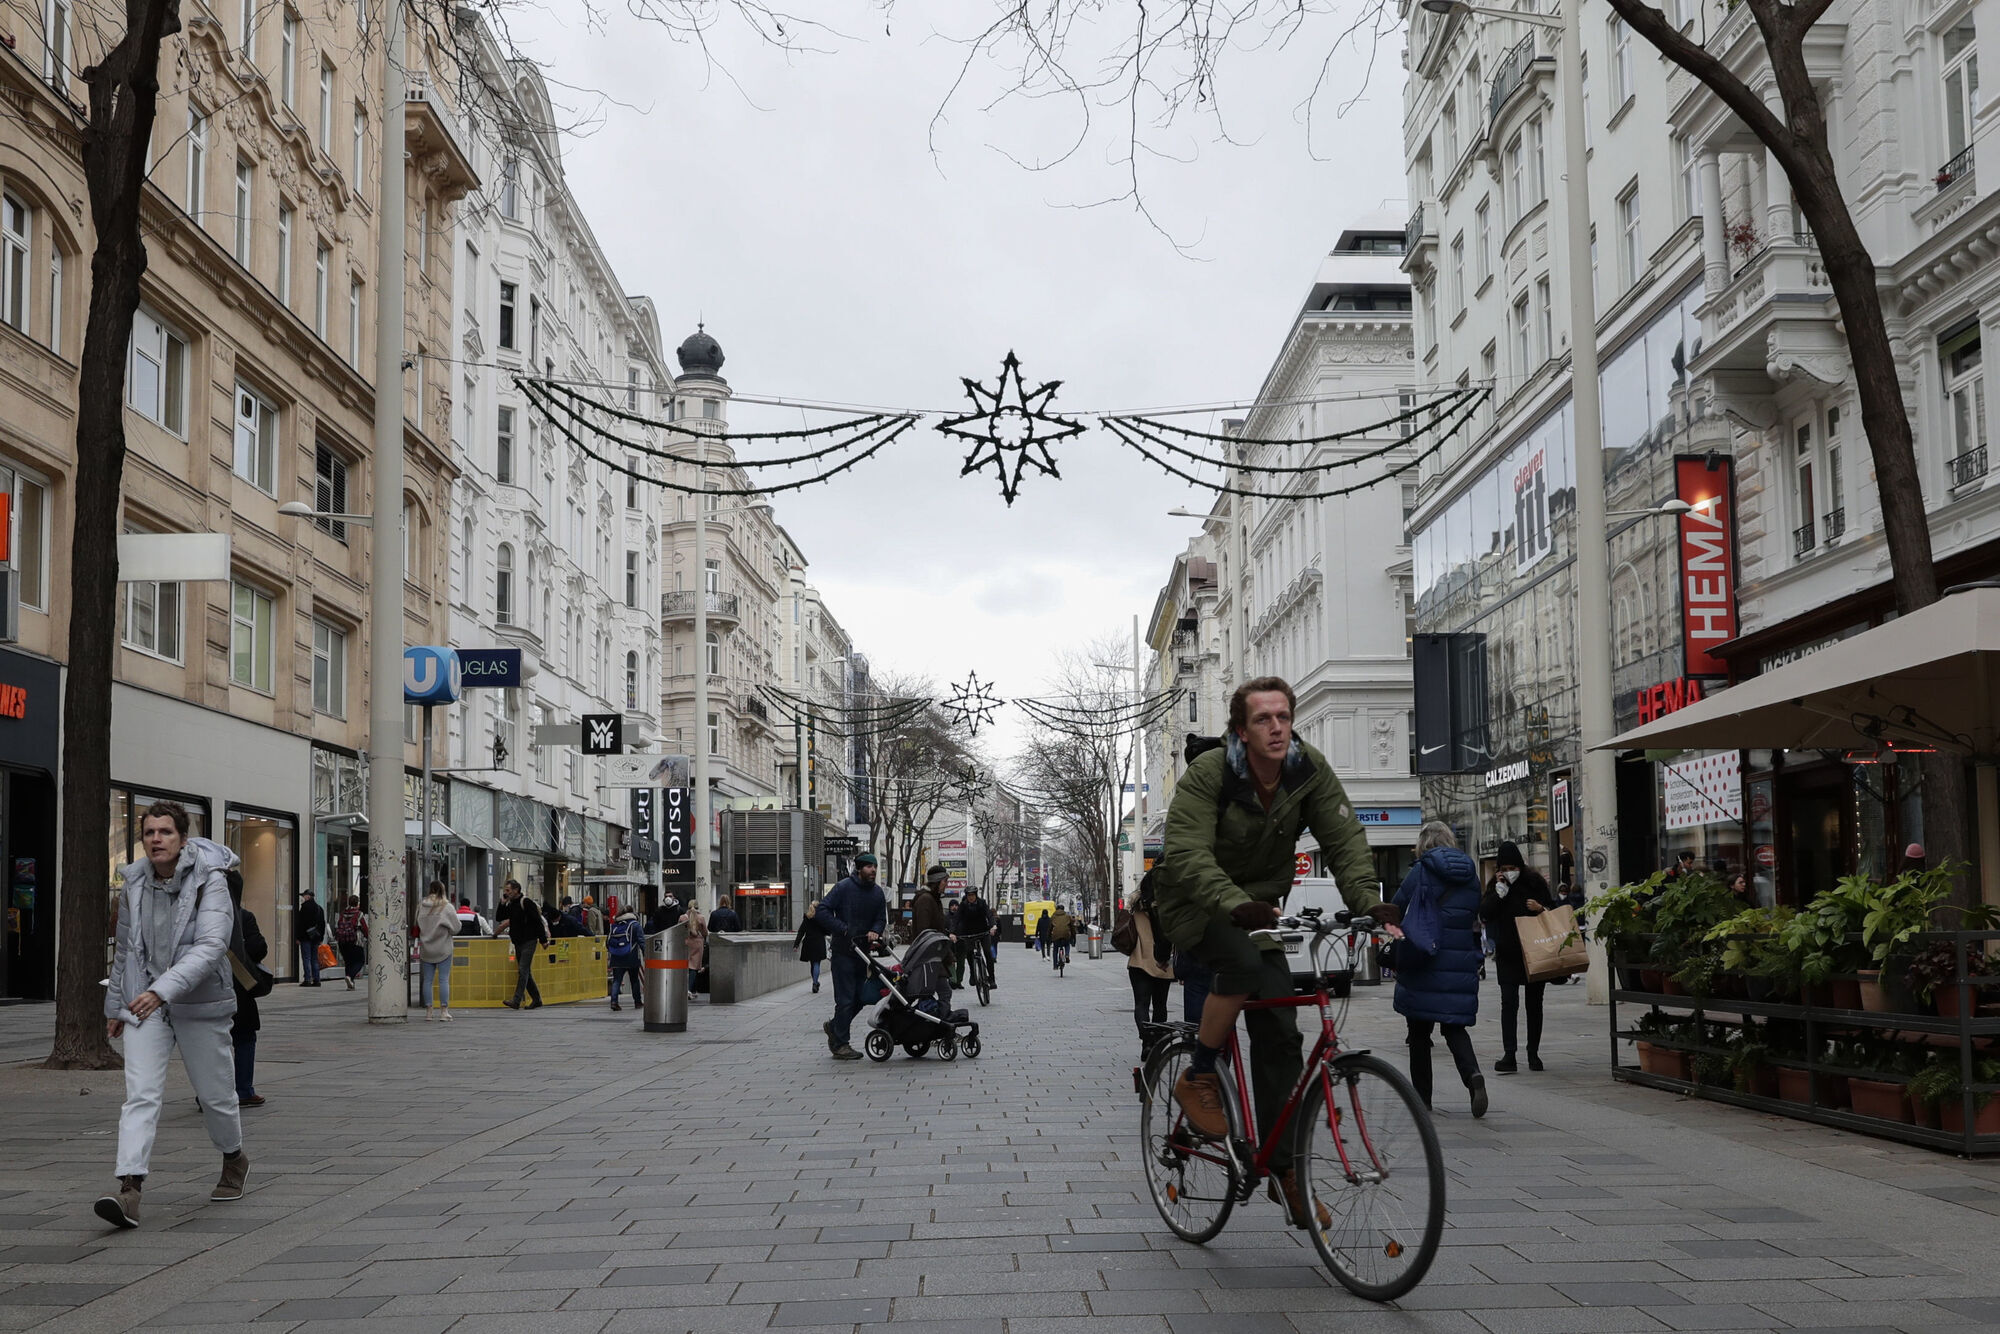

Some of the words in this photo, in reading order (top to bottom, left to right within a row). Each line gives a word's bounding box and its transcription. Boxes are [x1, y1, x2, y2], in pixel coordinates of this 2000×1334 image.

[1514, 449, 1544, 492] clever
[1515, 468, 1548, 568] fit
[1685, 495, 1729, 639] HEMA
[403, 657, 437, 693] U
[1637, 676, 1702, 727] HEMA
[1485, 760, 1530, 788] CALZEDONIA
[669, 788, 688, 856] orsa
